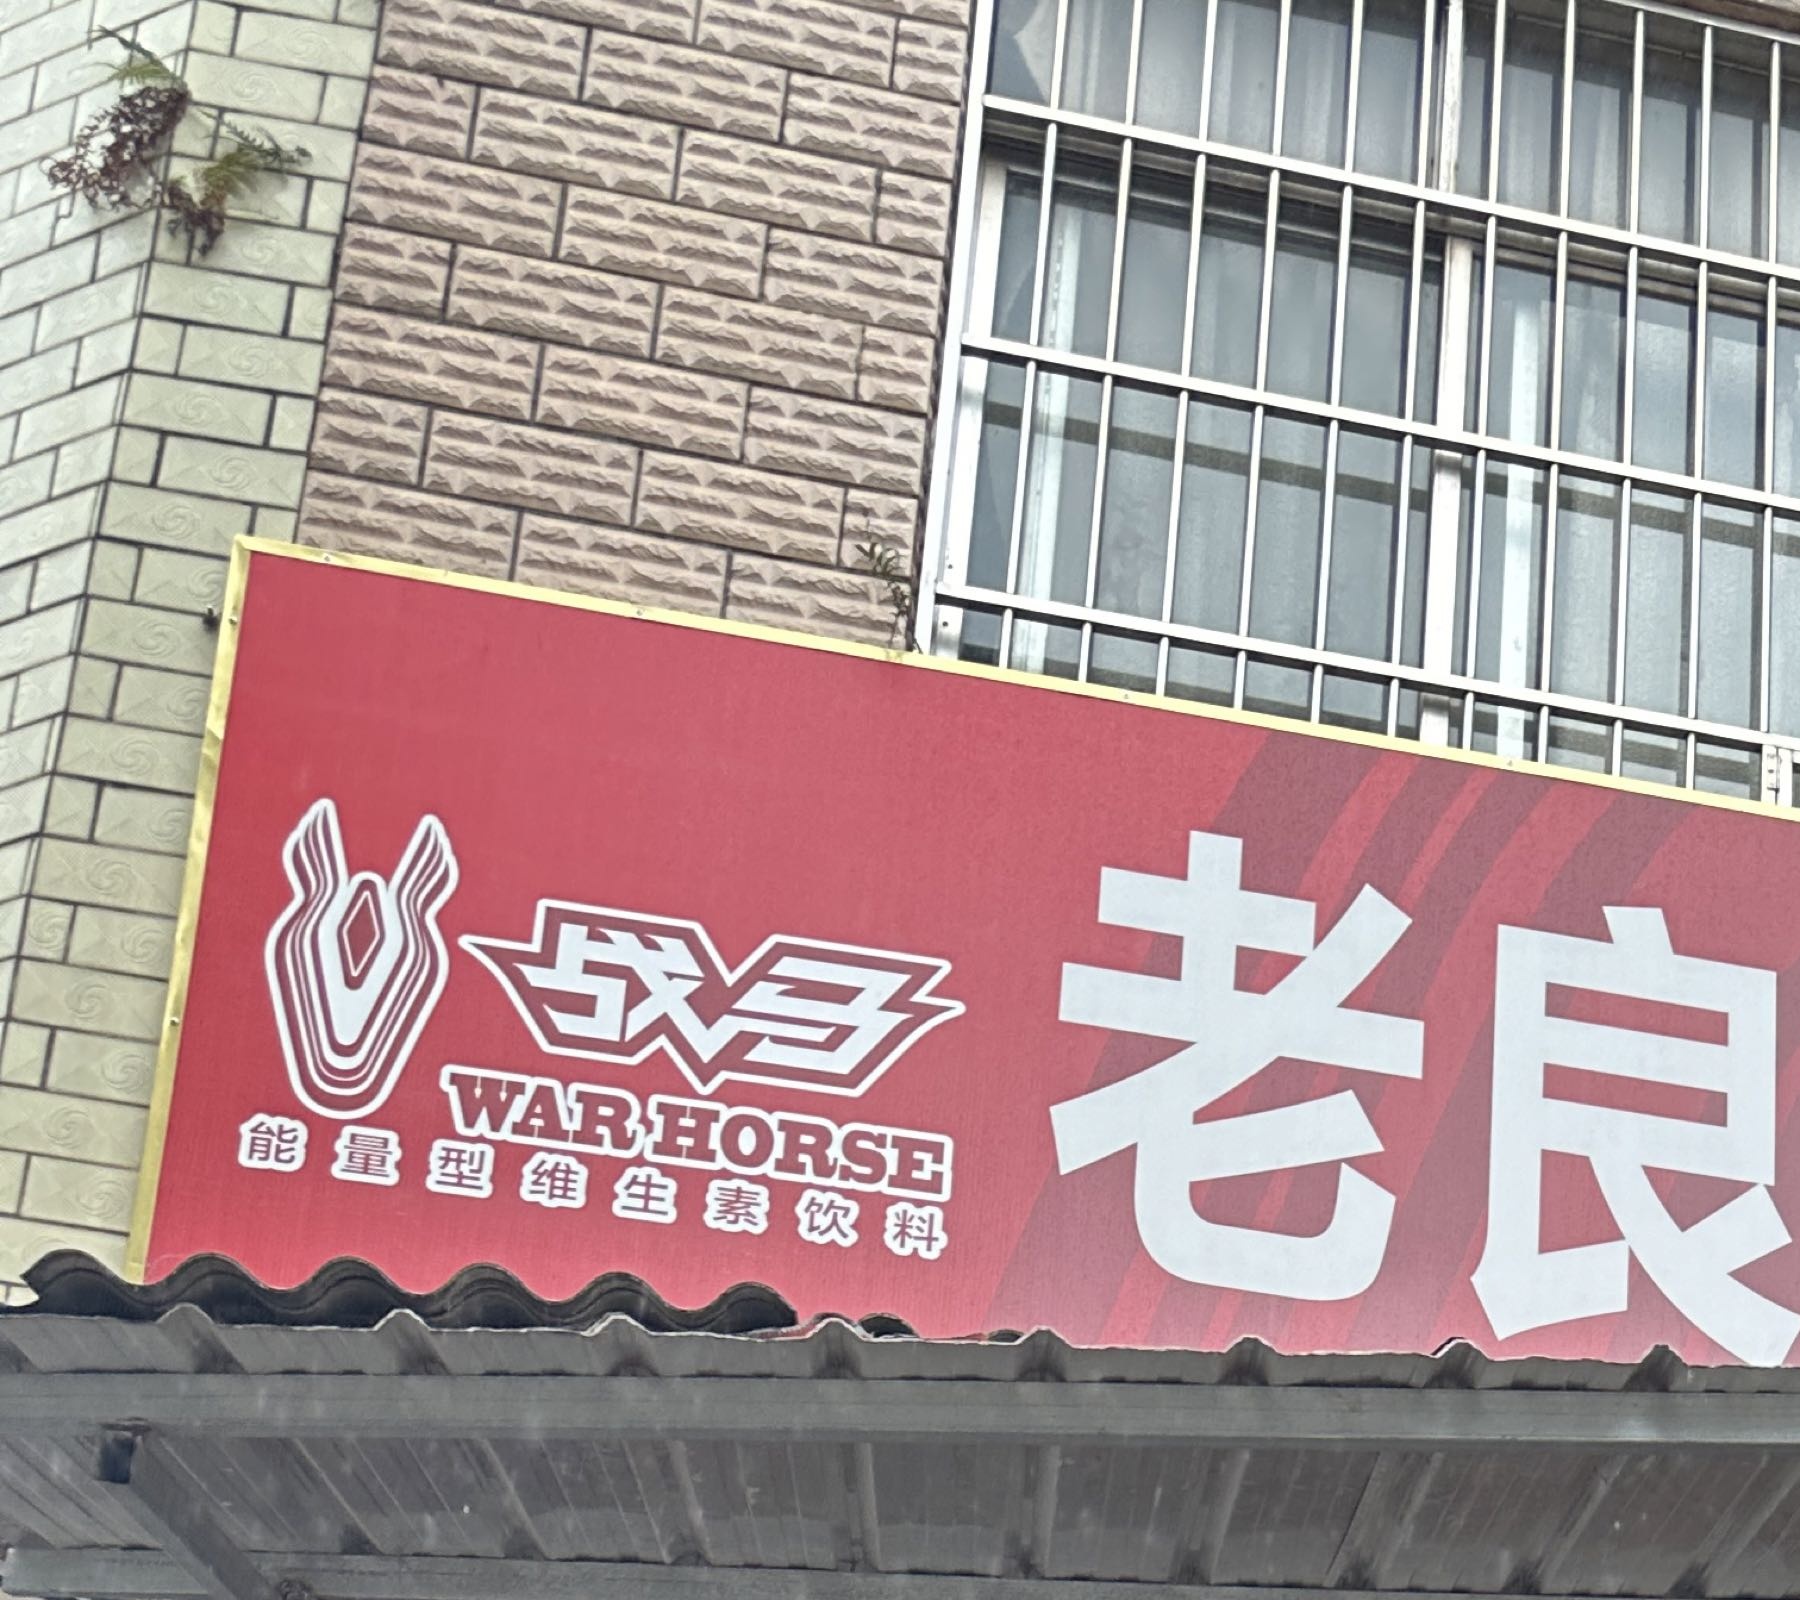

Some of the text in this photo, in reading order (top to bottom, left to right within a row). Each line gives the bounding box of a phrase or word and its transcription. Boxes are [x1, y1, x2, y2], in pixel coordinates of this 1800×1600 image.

[237, 1114, 946, 1260] 能量型维生素饮料
[444, 1064, 953, 1204] WAR HORSE
